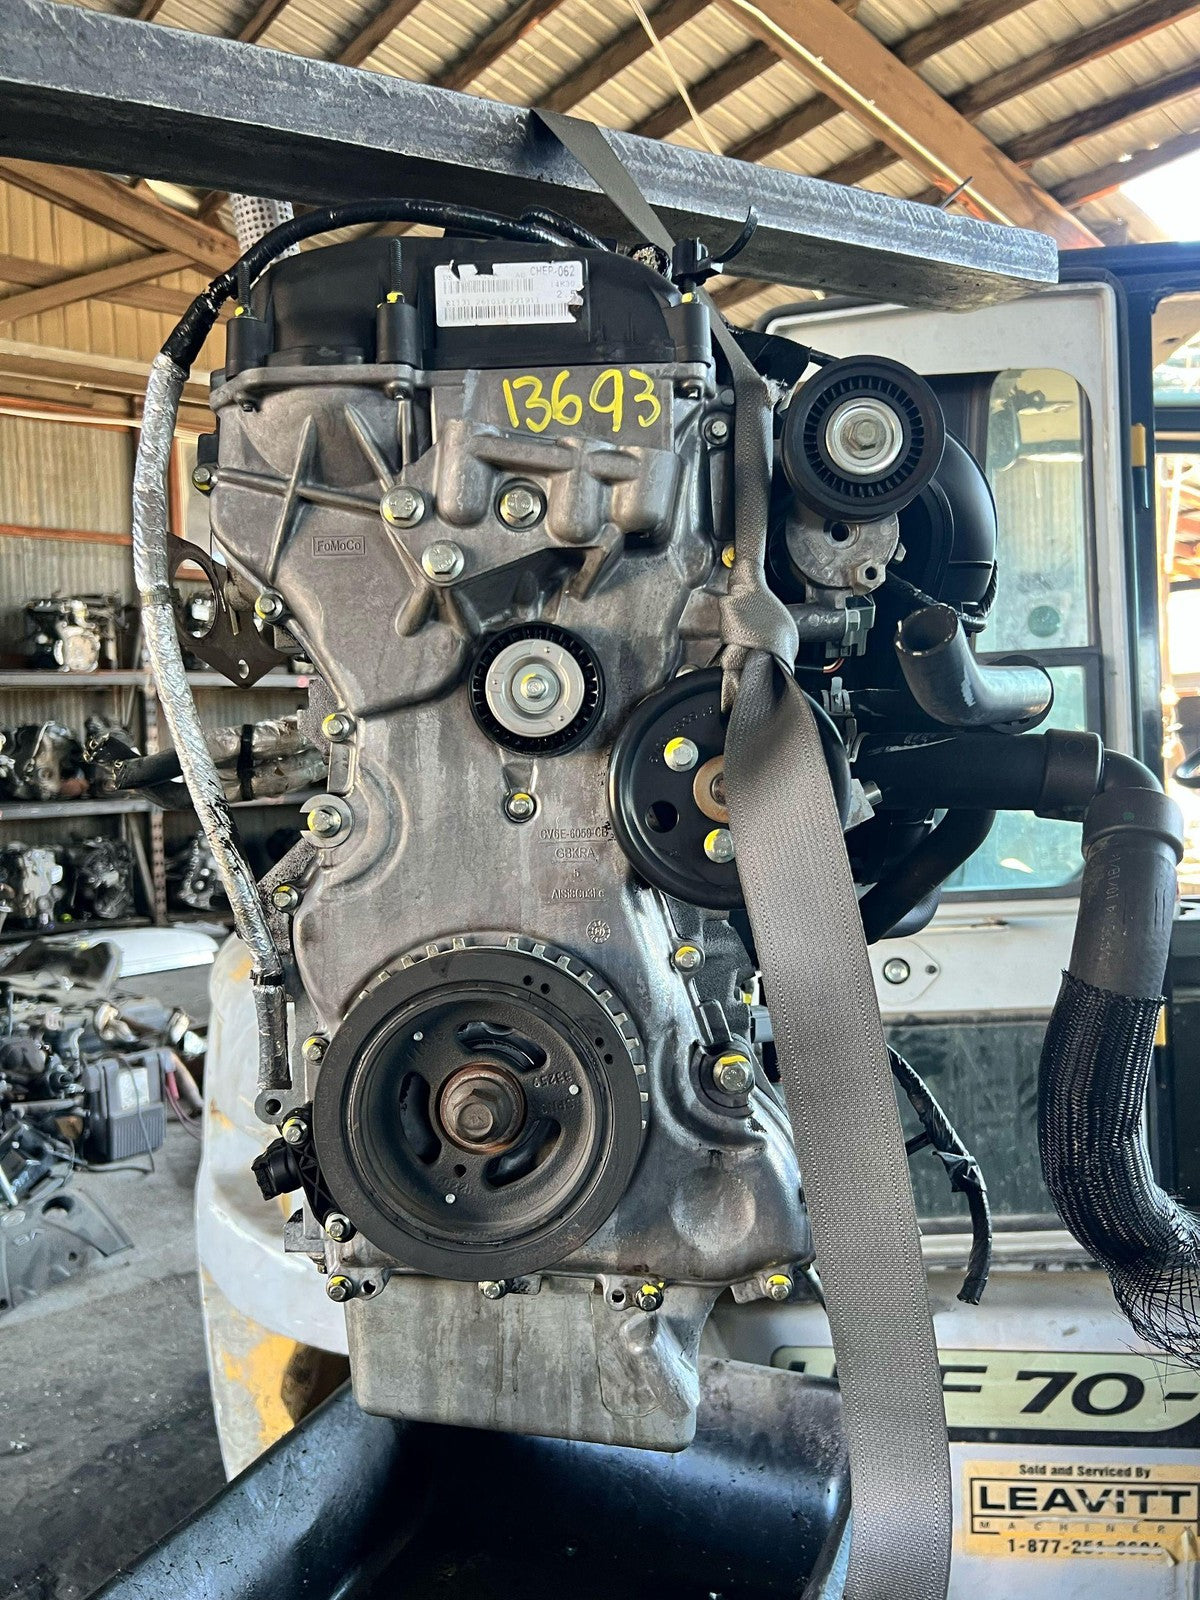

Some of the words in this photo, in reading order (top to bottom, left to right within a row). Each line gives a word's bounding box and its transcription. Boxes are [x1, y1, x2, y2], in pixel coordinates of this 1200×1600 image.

[502, 369, 662, 433] 13693
[316, 539, 361, 553] FoMoCo
[1019, 1464, 1047, 1476] Sold
[1050, 1464, 1073, 1477] and
[1076, 1465, 1133, 1478] Serviced
[1135, 1466, 1152, 1480] By
[979, 1485, 1192, 1515] LEAVITT
